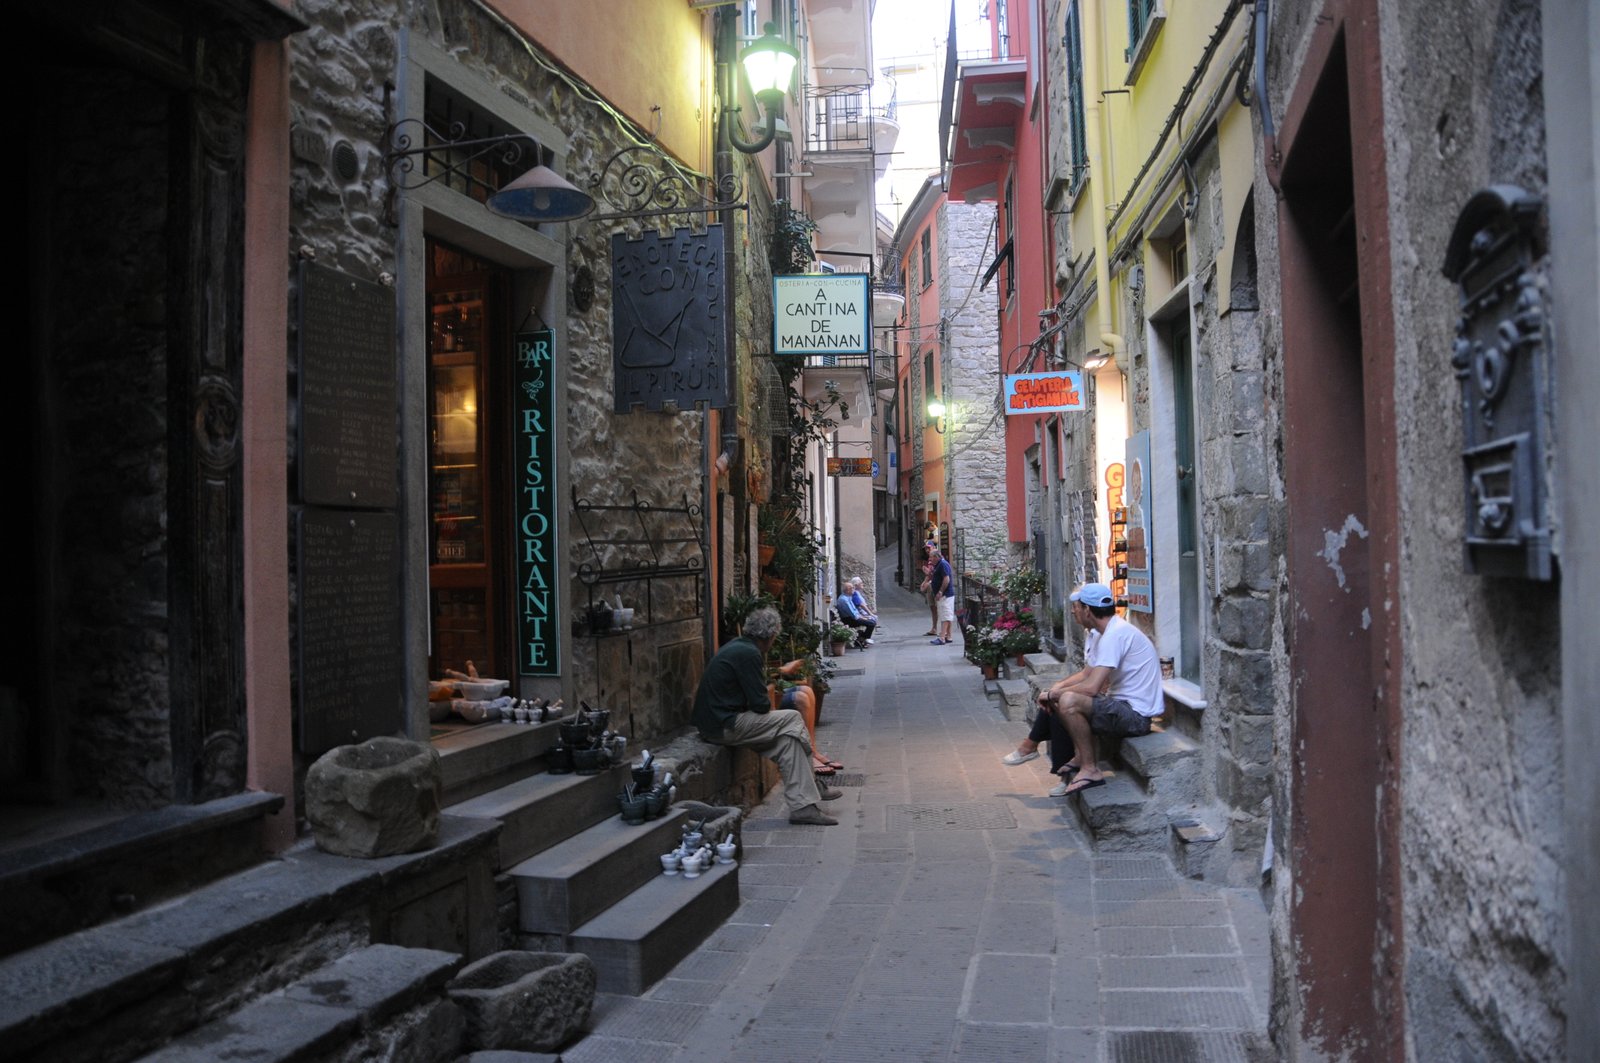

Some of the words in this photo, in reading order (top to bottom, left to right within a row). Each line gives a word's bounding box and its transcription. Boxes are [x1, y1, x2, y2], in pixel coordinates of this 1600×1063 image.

[616, 242, 719, 277] ENOTECA
[639, 266, 700, 296] CON
[815, 288, 827, 301] A
[785, 302, 857, 316] CANTINA
[706, 271, 719, 368] CUCINA
[811, 319, 831, 333] DE
[781, 334, 861, 348] MANANAN
[517, 340, 551, 369] BAR
[623, 373, 641, 396] IL
[1014, 376, 1073, 394] GELATERIA
[1009, 391, 1080, 409] ARTIGIANALE
[521, 409, 550, 667] RISTORANTE
